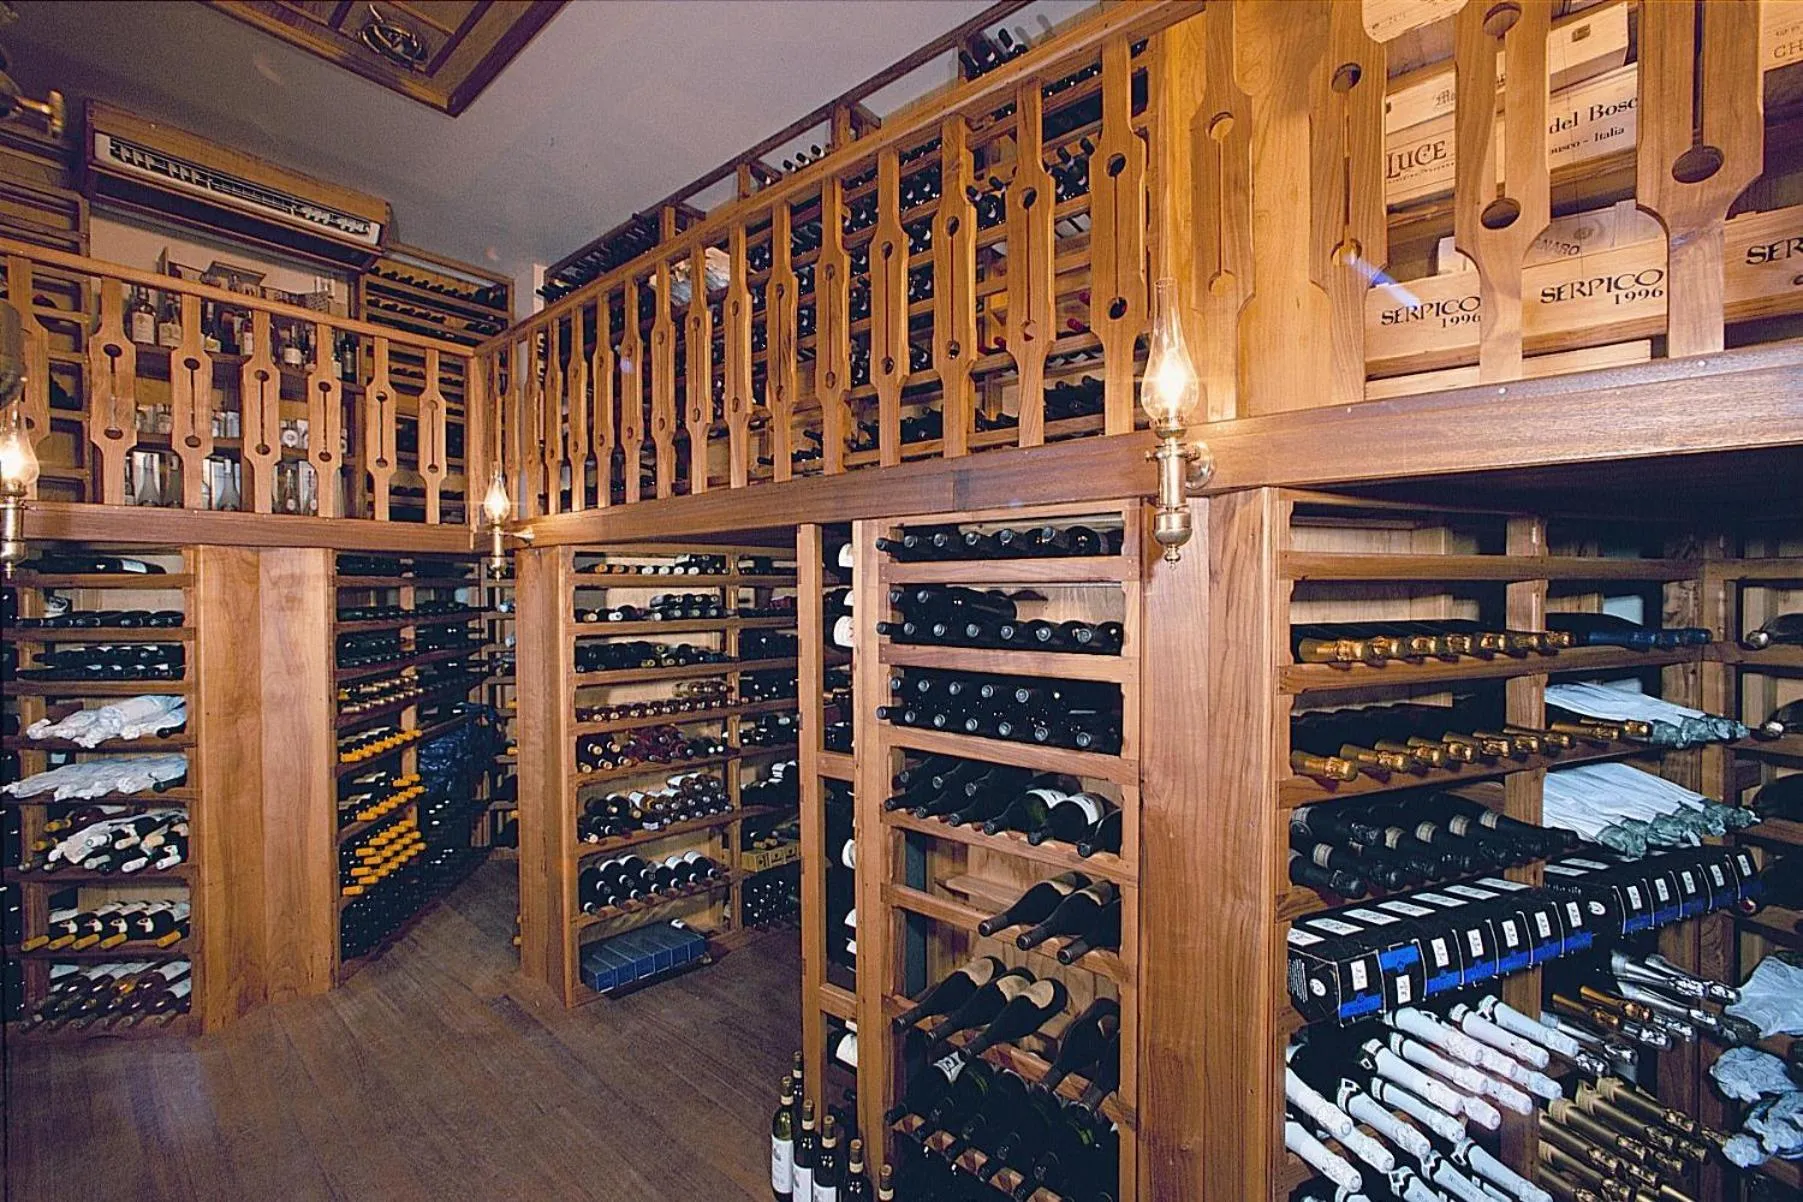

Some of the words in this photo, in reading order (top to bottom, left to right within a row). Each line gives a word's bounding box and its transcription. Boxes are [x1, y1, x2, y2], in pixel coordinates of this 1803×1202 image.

[1594, 127, 1625, 142] Italia
[1540, 269, 1664, 304] SERPICO
[1614, 287, 1664, 305] 1996
[1381, 296, 1480, 326] SERPICO
[1441, 313, 1480, 328] 1996
